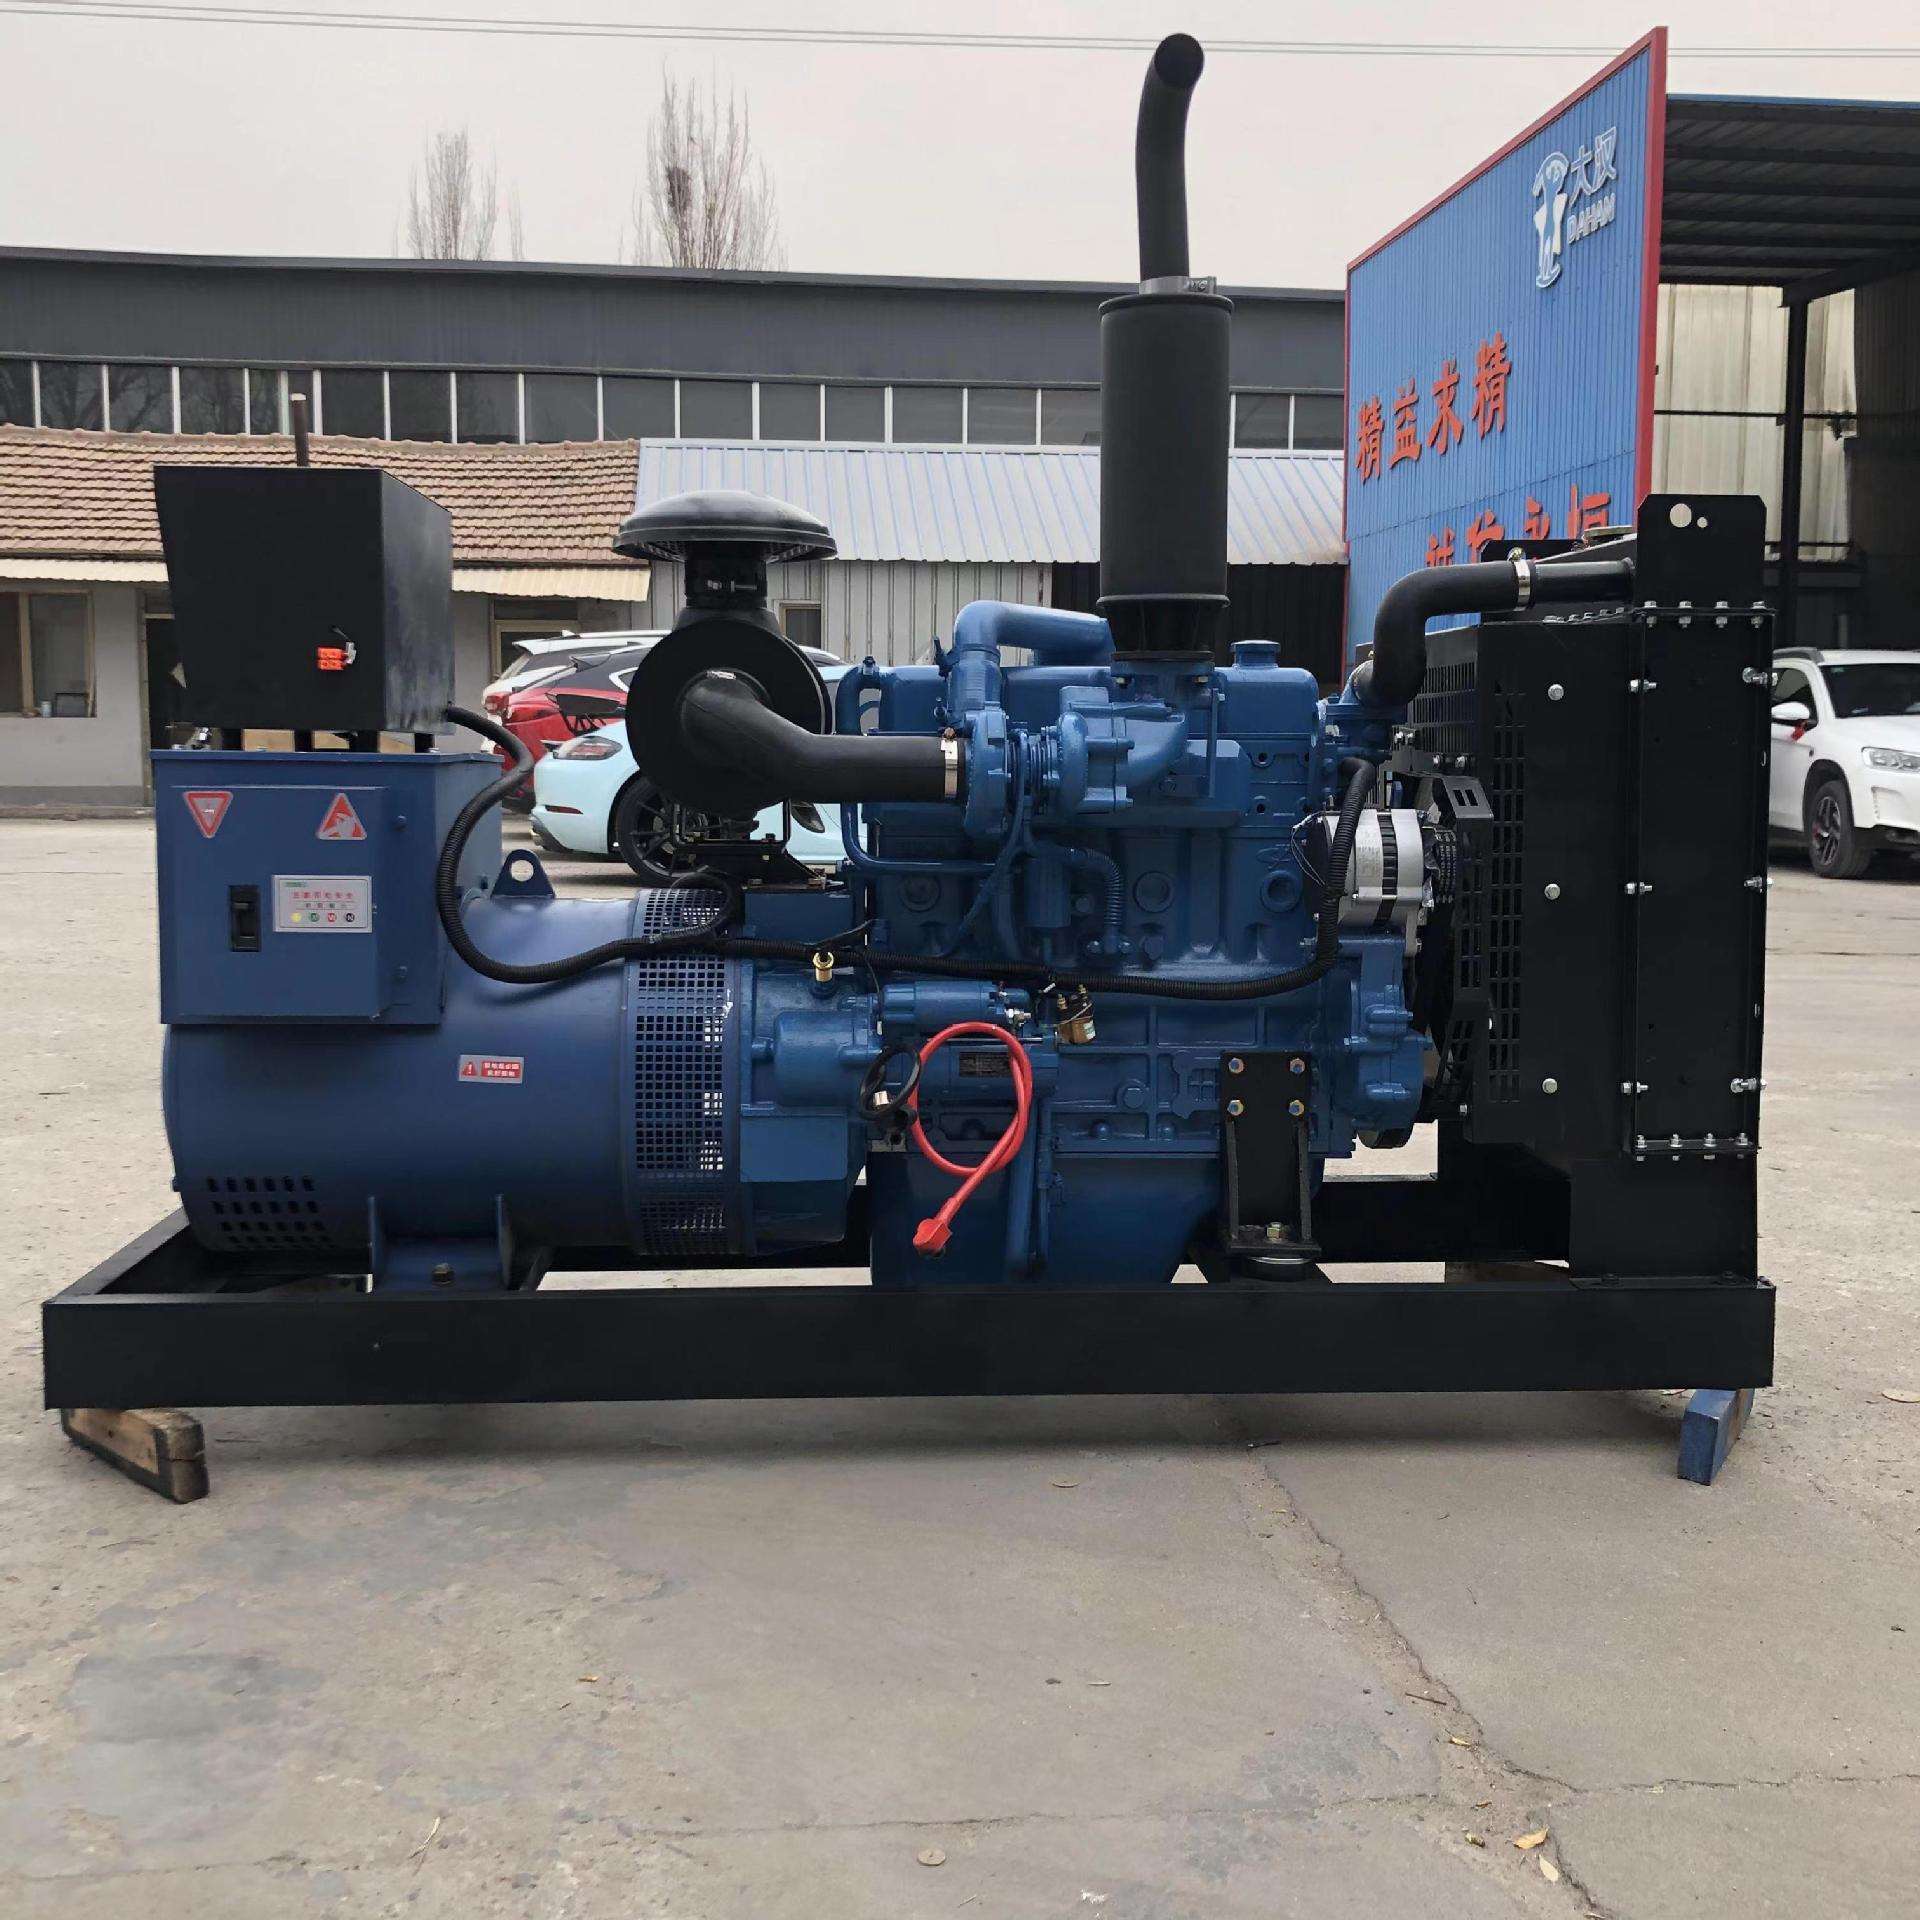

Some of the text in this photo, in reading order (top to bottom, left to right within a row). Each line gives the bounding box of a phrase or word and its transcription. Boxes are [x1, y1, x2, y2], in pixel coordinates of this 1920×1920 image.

[1569, 126, 1618, 208] 大汉
[1566, 192, 1617, 244] DAHAN
[1355, 330, 1513, 486] 精益求精
